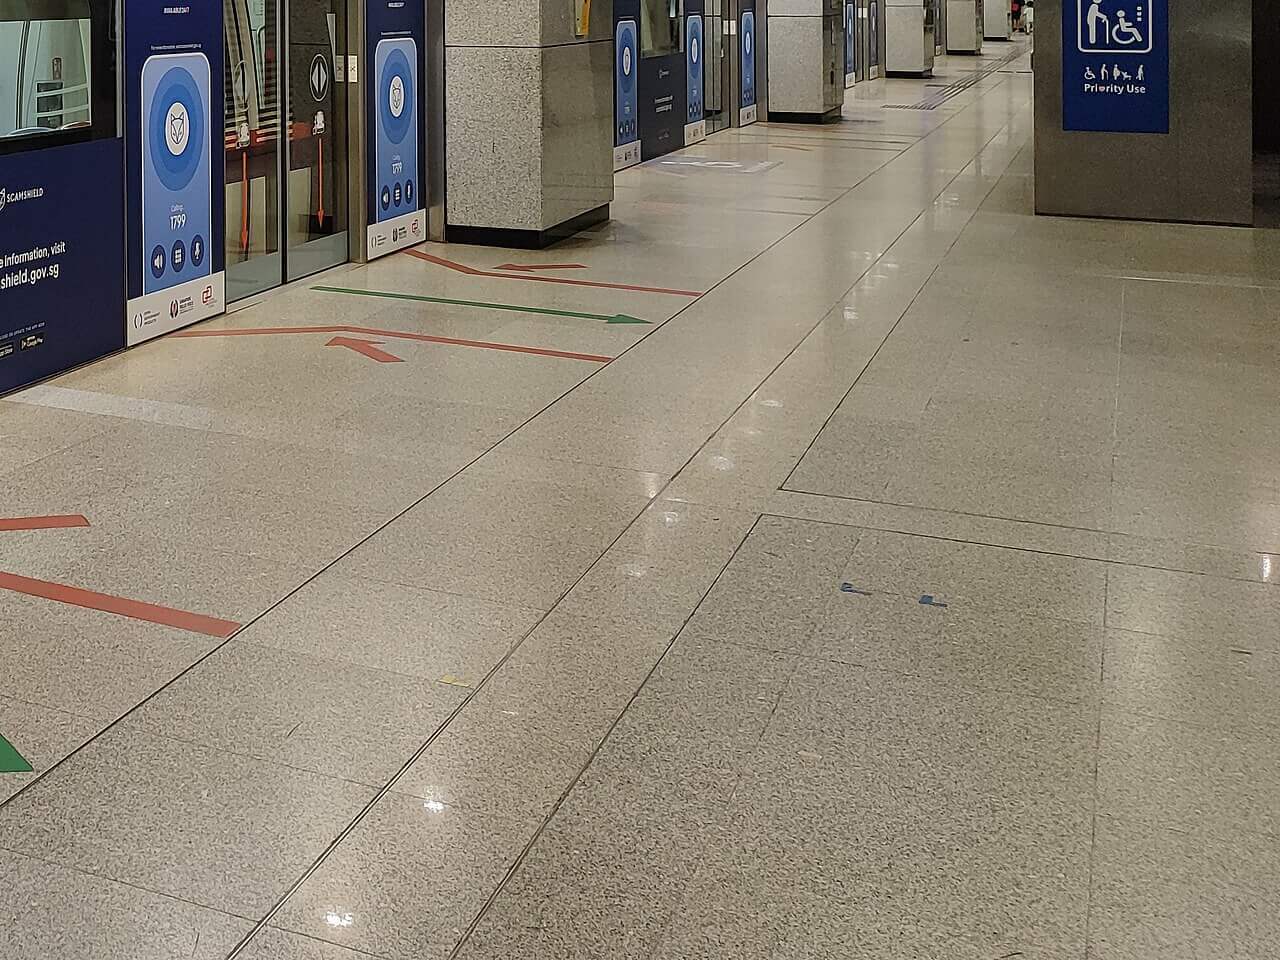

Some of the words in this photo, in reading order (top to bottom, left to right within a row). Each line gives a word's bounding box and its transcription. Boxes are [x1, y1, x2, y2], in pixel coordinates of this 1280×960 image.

[1084, 82, 1124, 95] Priority
[1126, 84, 1146, 94] Use
[6, 187, 44, 203] SCAMSHIELD
[170, 213, 187, 230] 1799
[4, 246, 50, 267] information,
[50, 240, 66, 256] visit
